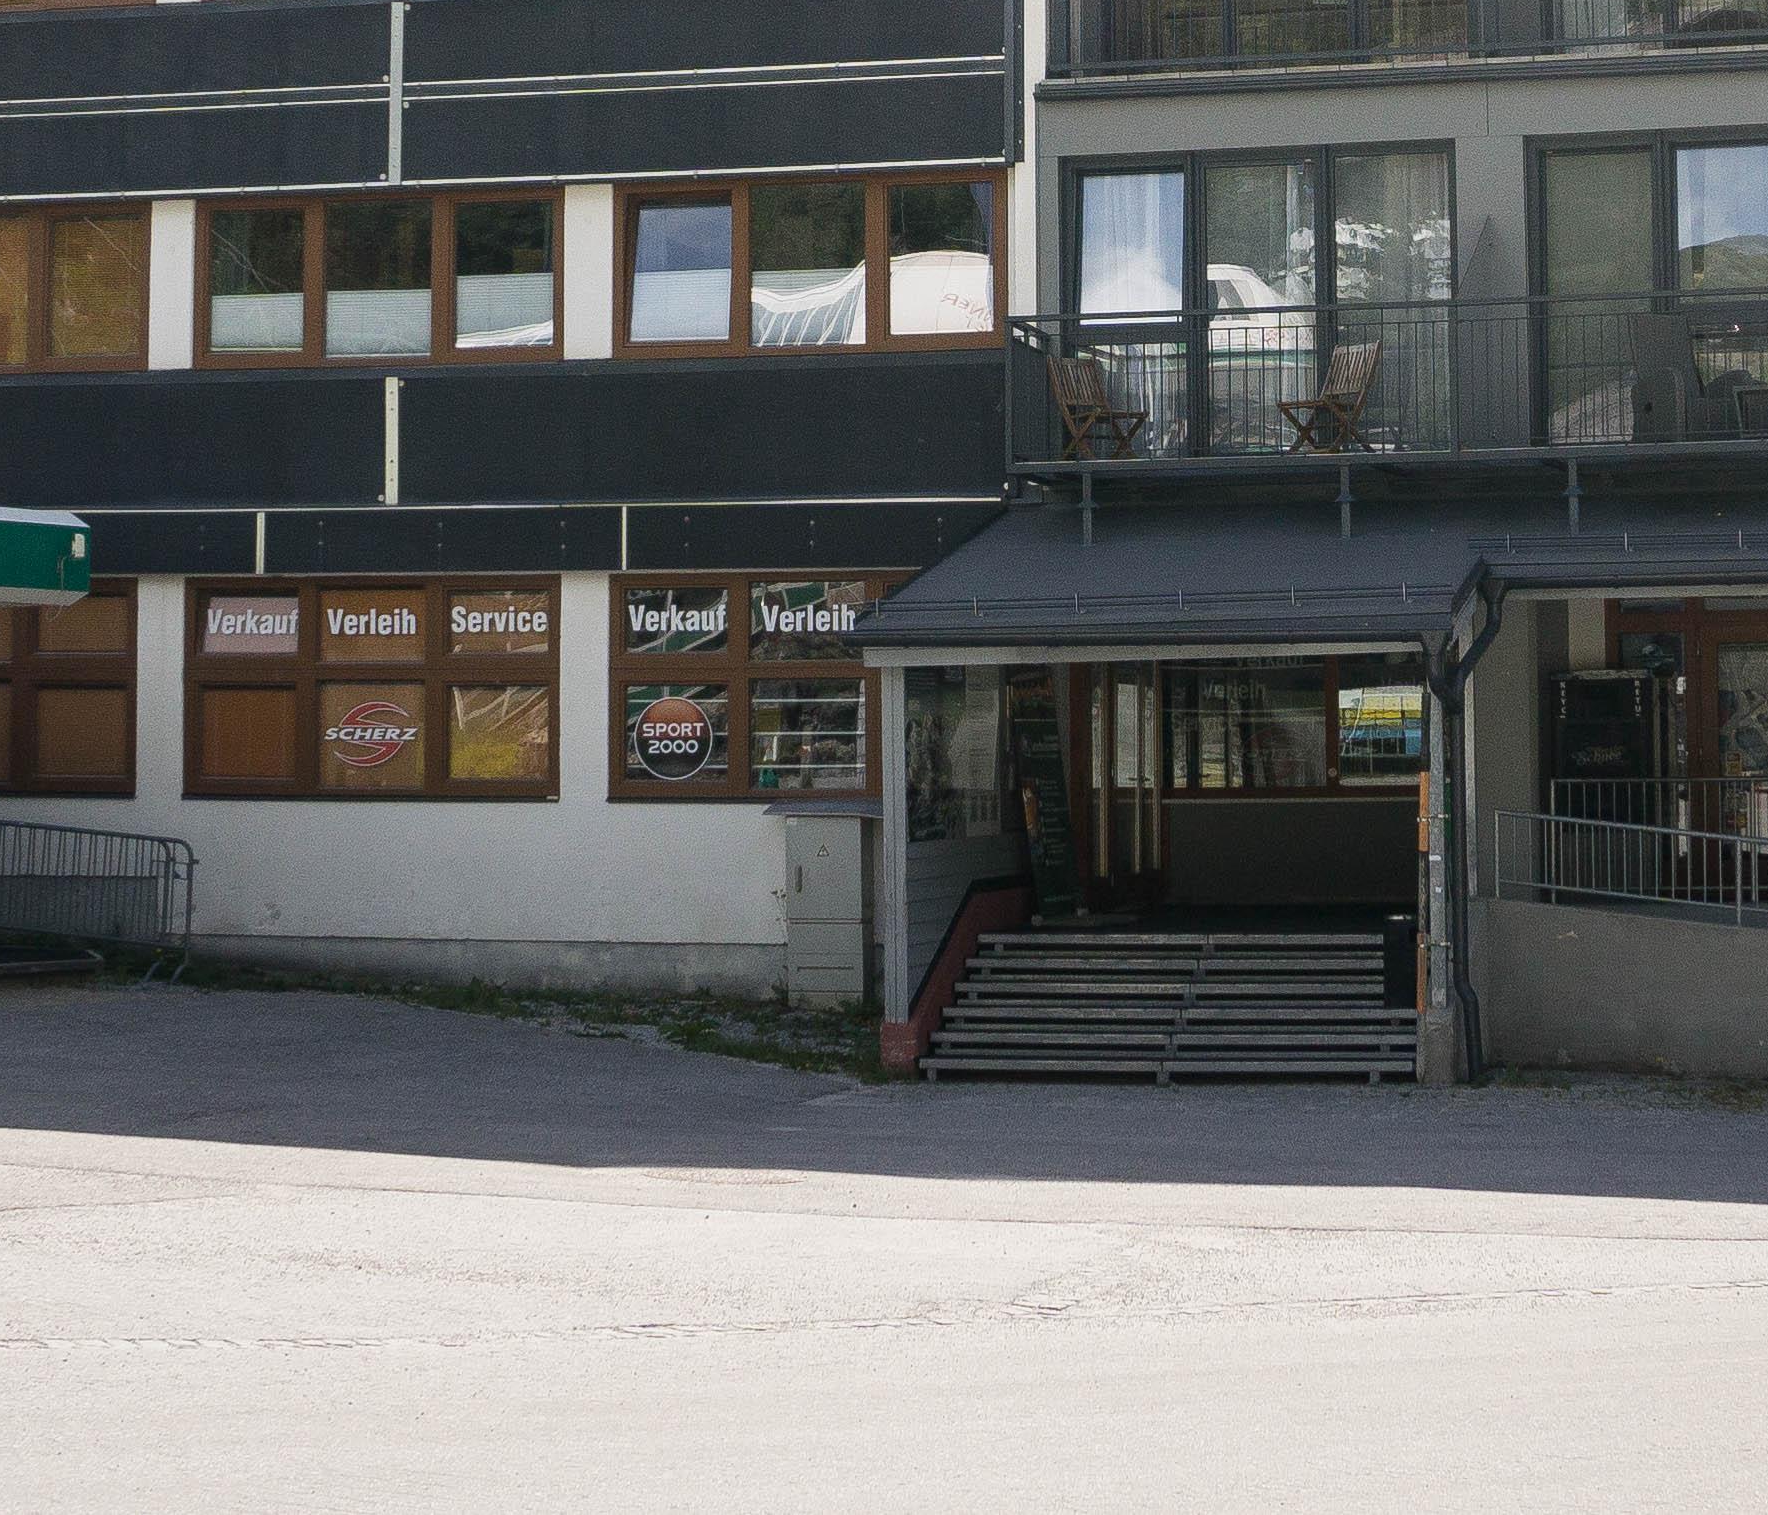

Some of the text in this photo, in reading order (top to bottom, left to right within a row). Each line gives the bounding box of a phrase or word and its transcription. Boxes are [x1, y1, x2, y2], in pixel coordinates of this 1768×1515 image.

[207, 605, 547, 635] Verkauf Verleih Service
[628, 603, 857, 632] Verkauf Verleih
[324, 726, 418, 741] SCHERZ
[642, 722, 704, 737] SPORT
[648, 740, 699, 754] 2000
